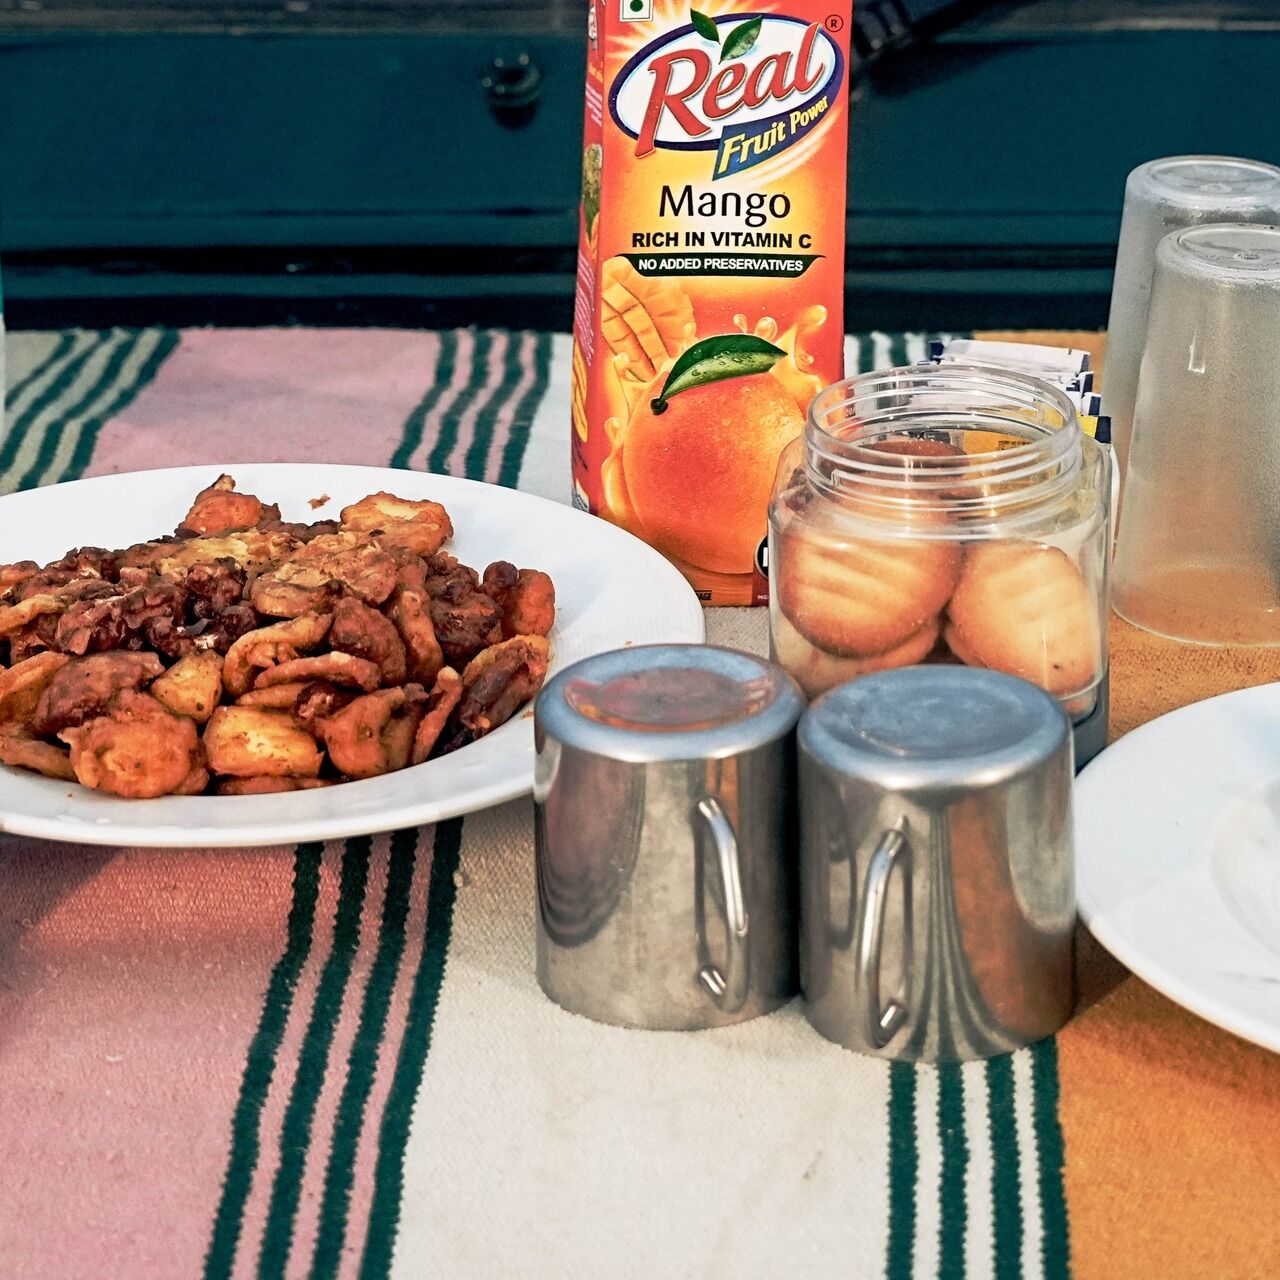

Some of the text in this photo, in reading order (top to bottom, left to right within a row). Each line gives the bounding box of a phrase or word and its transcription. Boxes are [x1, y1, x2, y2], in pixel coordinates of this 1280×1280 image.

[635, 22, 825, 158] Real
[718, 97, 829, 175] Fruit Power
[659, 185, 791, 226] Mango
[632, 232, 812, 249] RICH IN VITAMIN C
[638, 258, 803, 272] NO ADDED PRESERVATIVES
